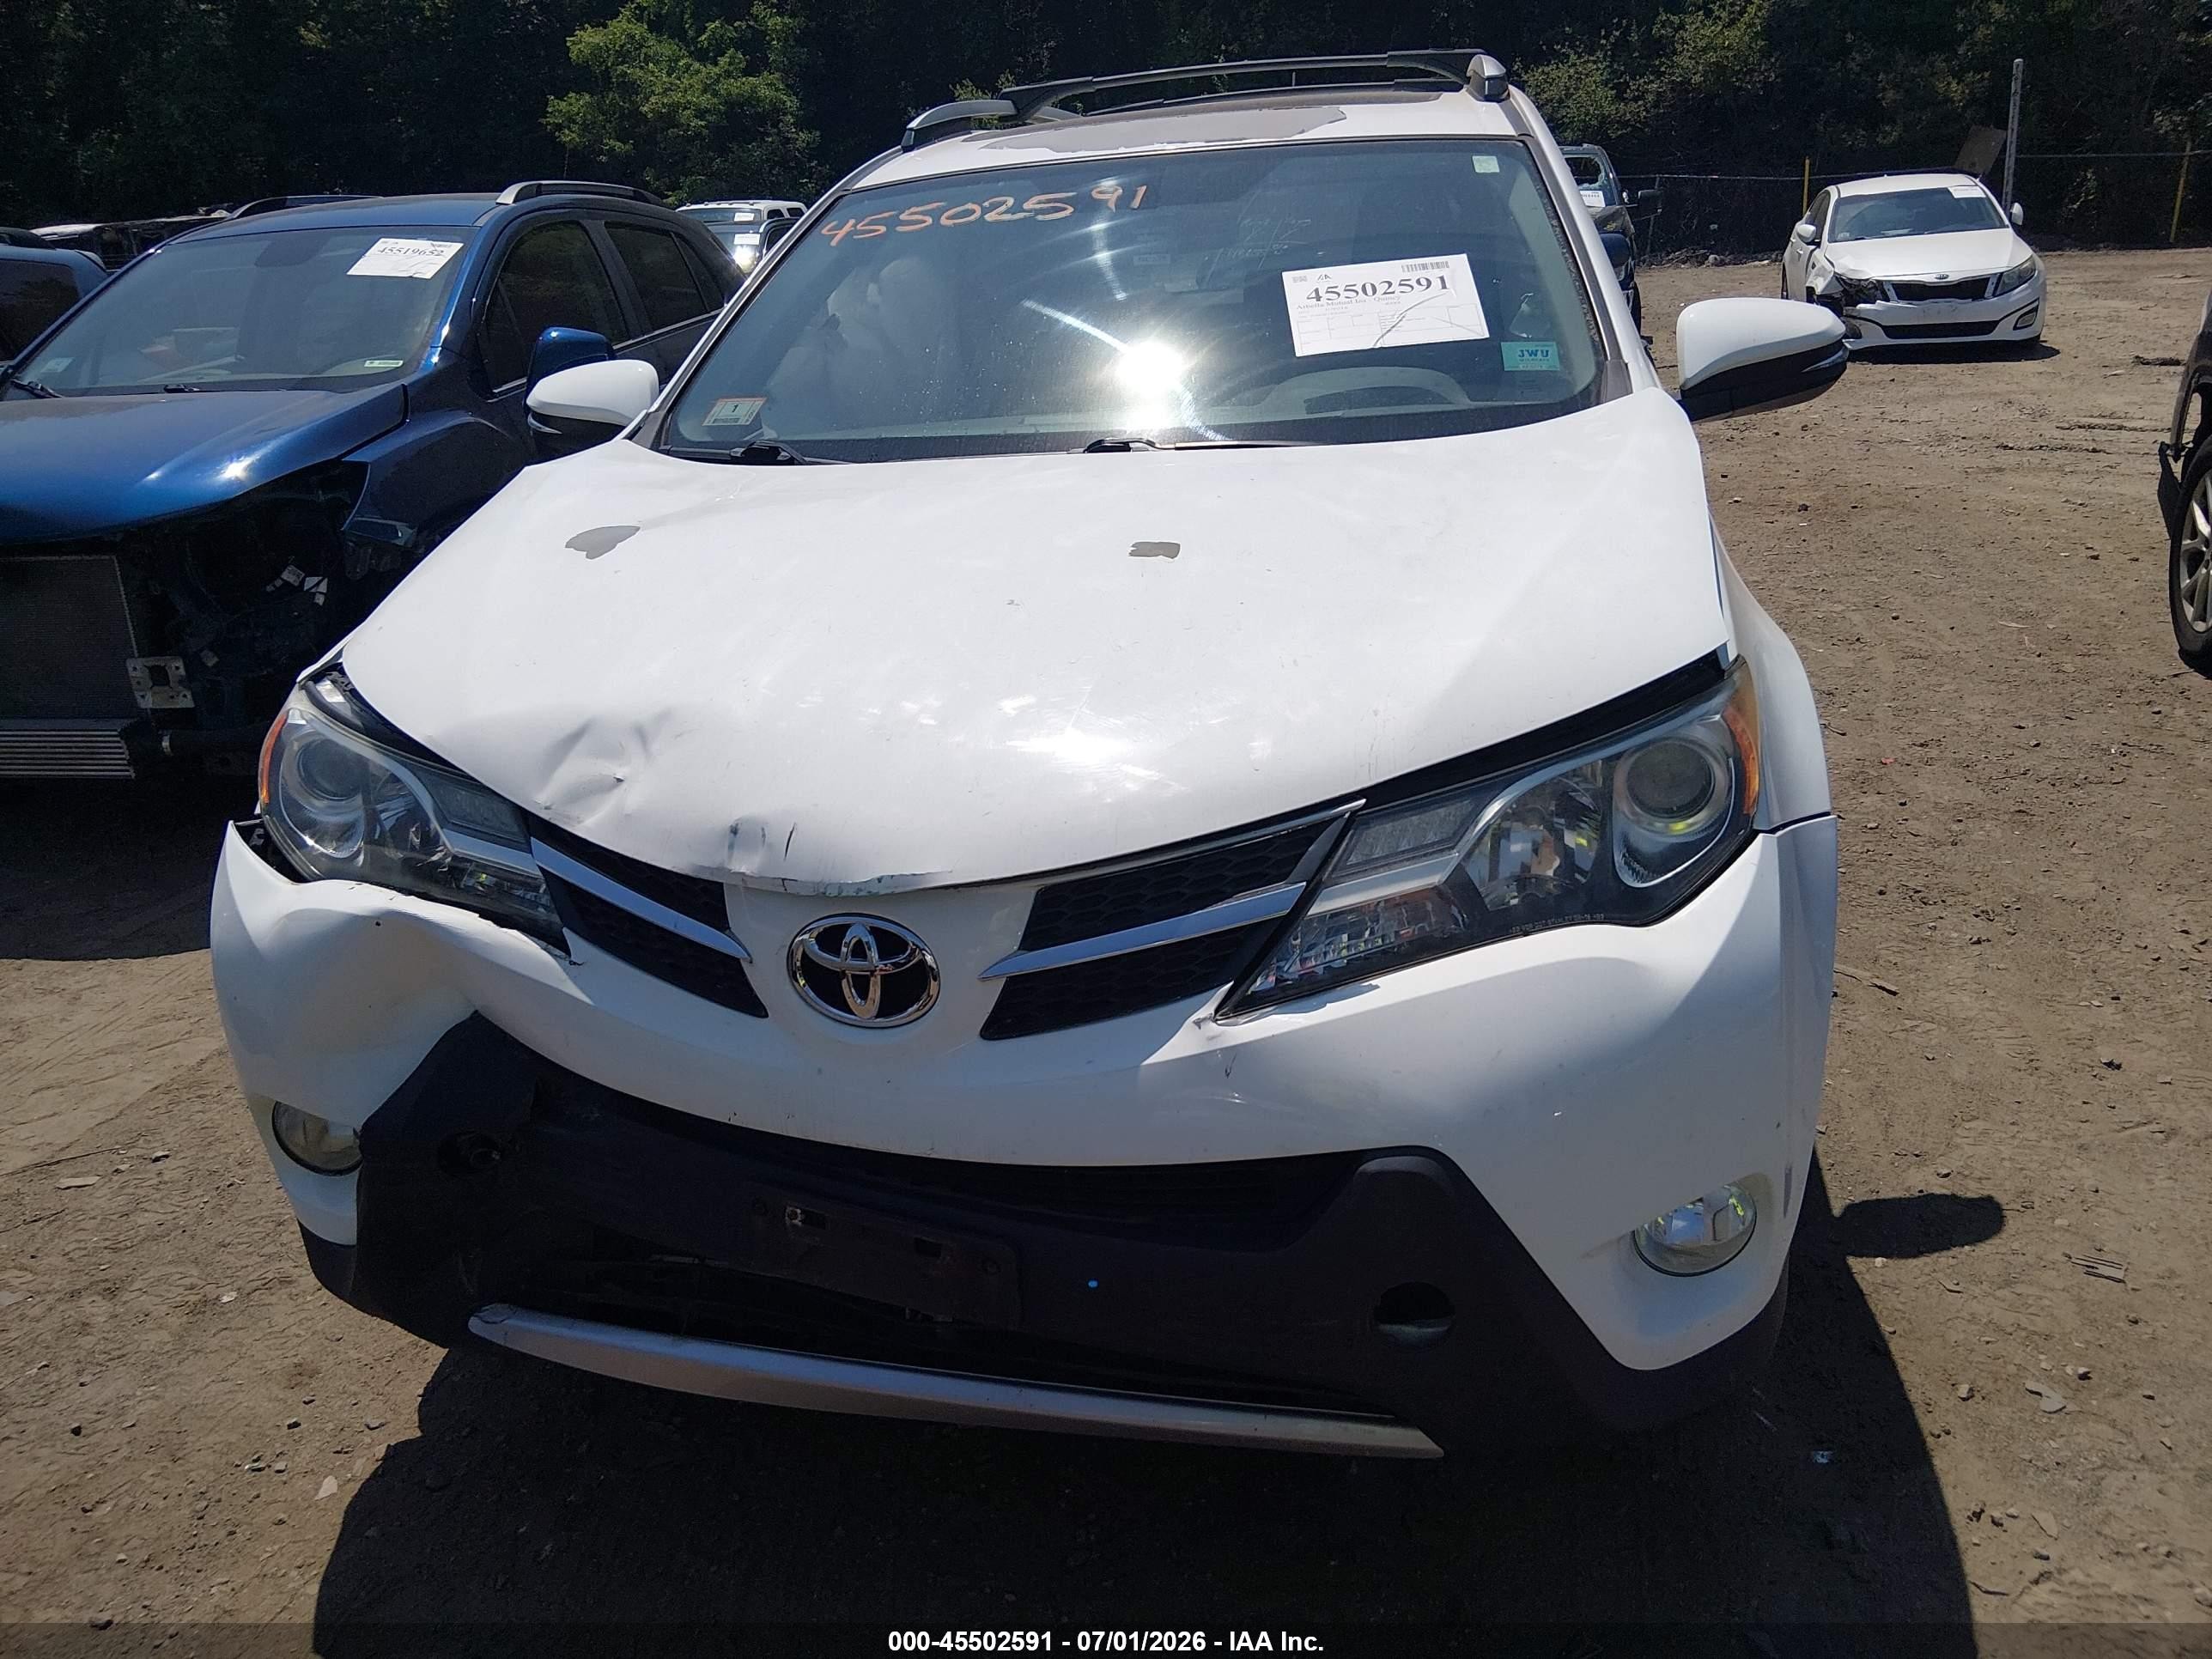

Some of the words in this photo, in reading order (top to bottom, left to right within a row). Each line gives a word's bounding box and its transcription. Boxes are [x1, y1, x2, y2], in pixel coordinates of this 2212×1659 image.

[822, 184, 1147, 247] 45502591
[1306, 275, 1449, 302] 45502591
[1518, 349, 1550, 358] JWU
[732, 404, 739, 413] 1
